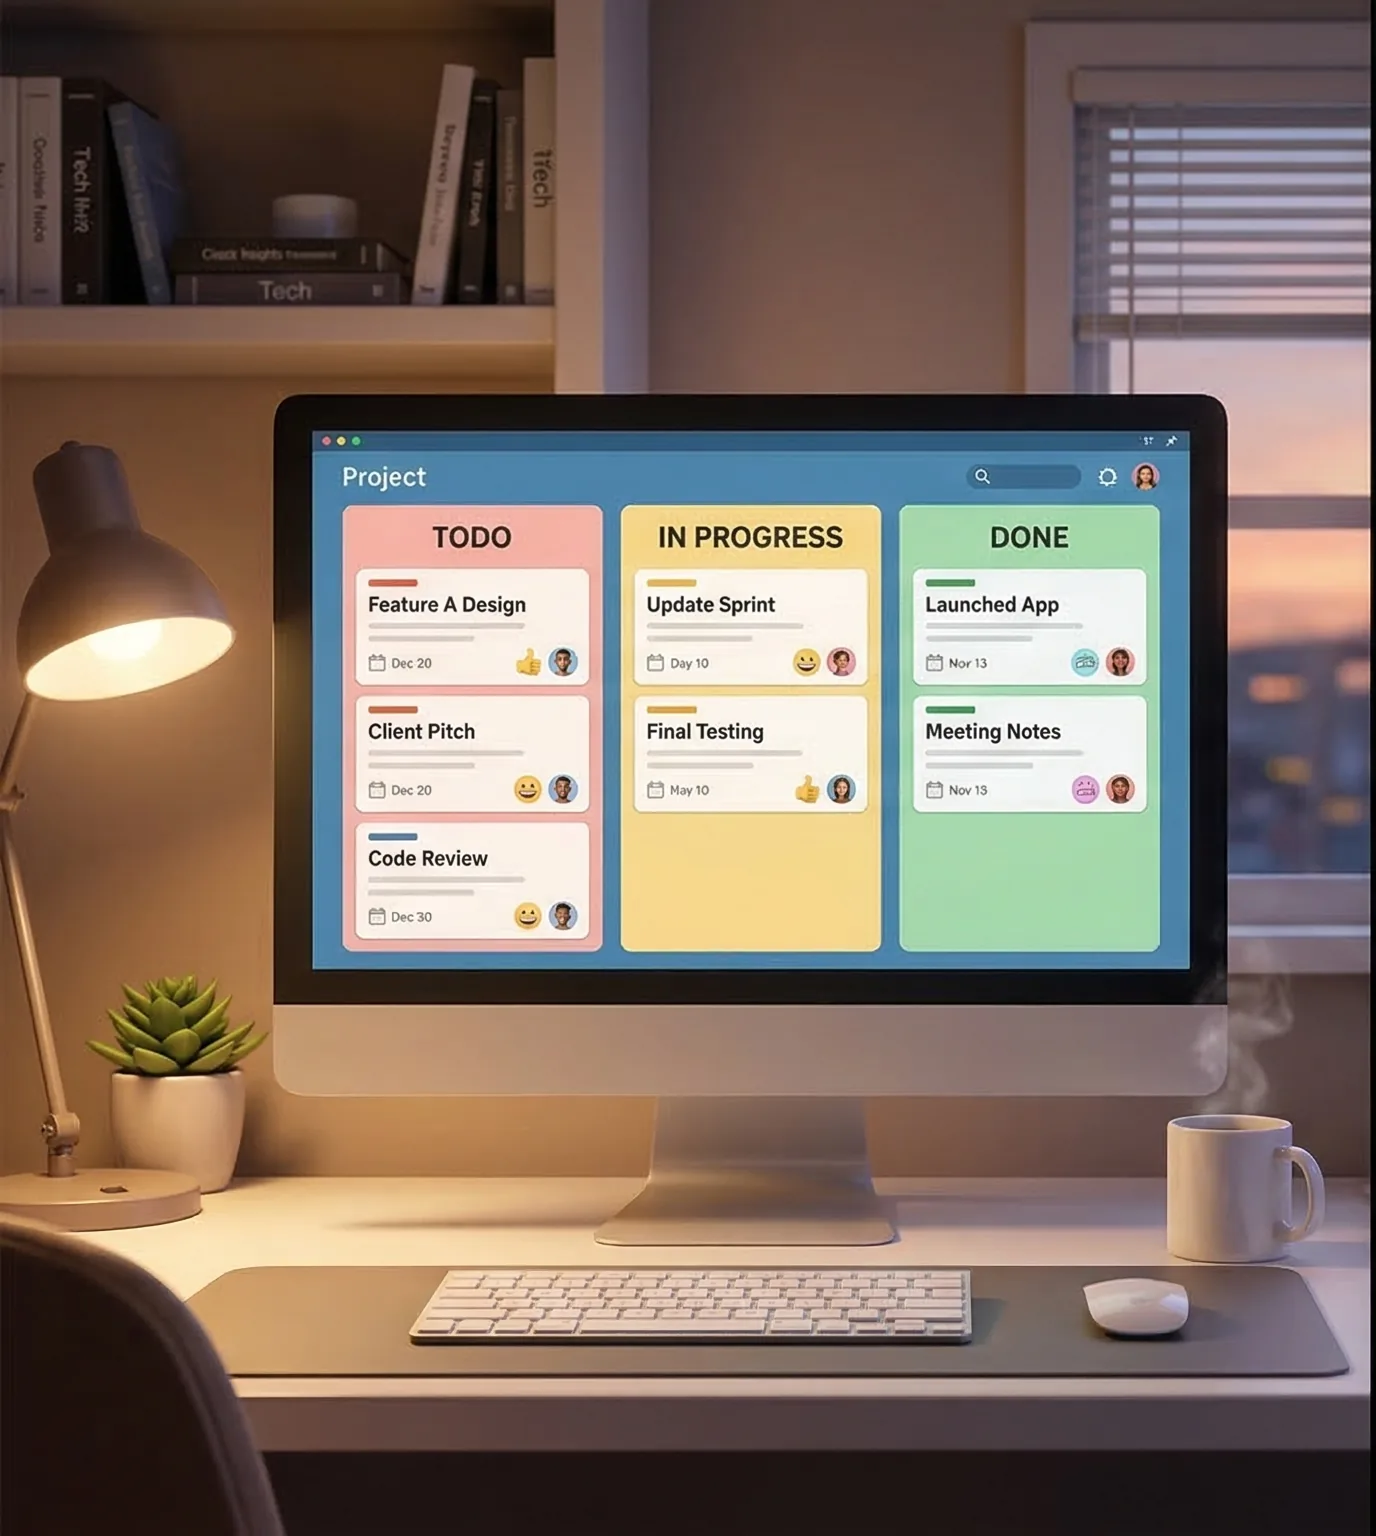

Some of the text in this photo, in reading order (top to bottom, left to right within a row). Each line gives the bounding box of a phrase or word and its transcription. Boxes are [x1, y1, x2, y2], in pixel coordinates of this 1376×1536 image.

[258, 280, 312, 300] Tech
[343, 466, 426, 491] Project
[432, 526, 512, 548] TODO
[658, 526, 843, 548] IN PROGRESS
[991, 526, 1069, 548] DONE
[368, 596, 526, 616] Feature A Design
[647, 596, 776, 616] Update Sprint
[926, 596, 1060, 616] Launched App
[391, 657, 432, 669] Dec 20
[671, 658, 709, 671] Day 10
[974, 658, 988, 669] 13
[368, 723, 475, 740] Client Pitch
[647, 723, 764, 743] Final Testing
[926, 723, 1061, 743] Meeting Notes
[391, 784, 432, 796] Dec 20
[670, 785, 709, 799] May 10
[949, 785, 988, 796] Nov 13
[368, 850, 488, 867] Code Review
[391, 911, 432, 923] Dec 30
